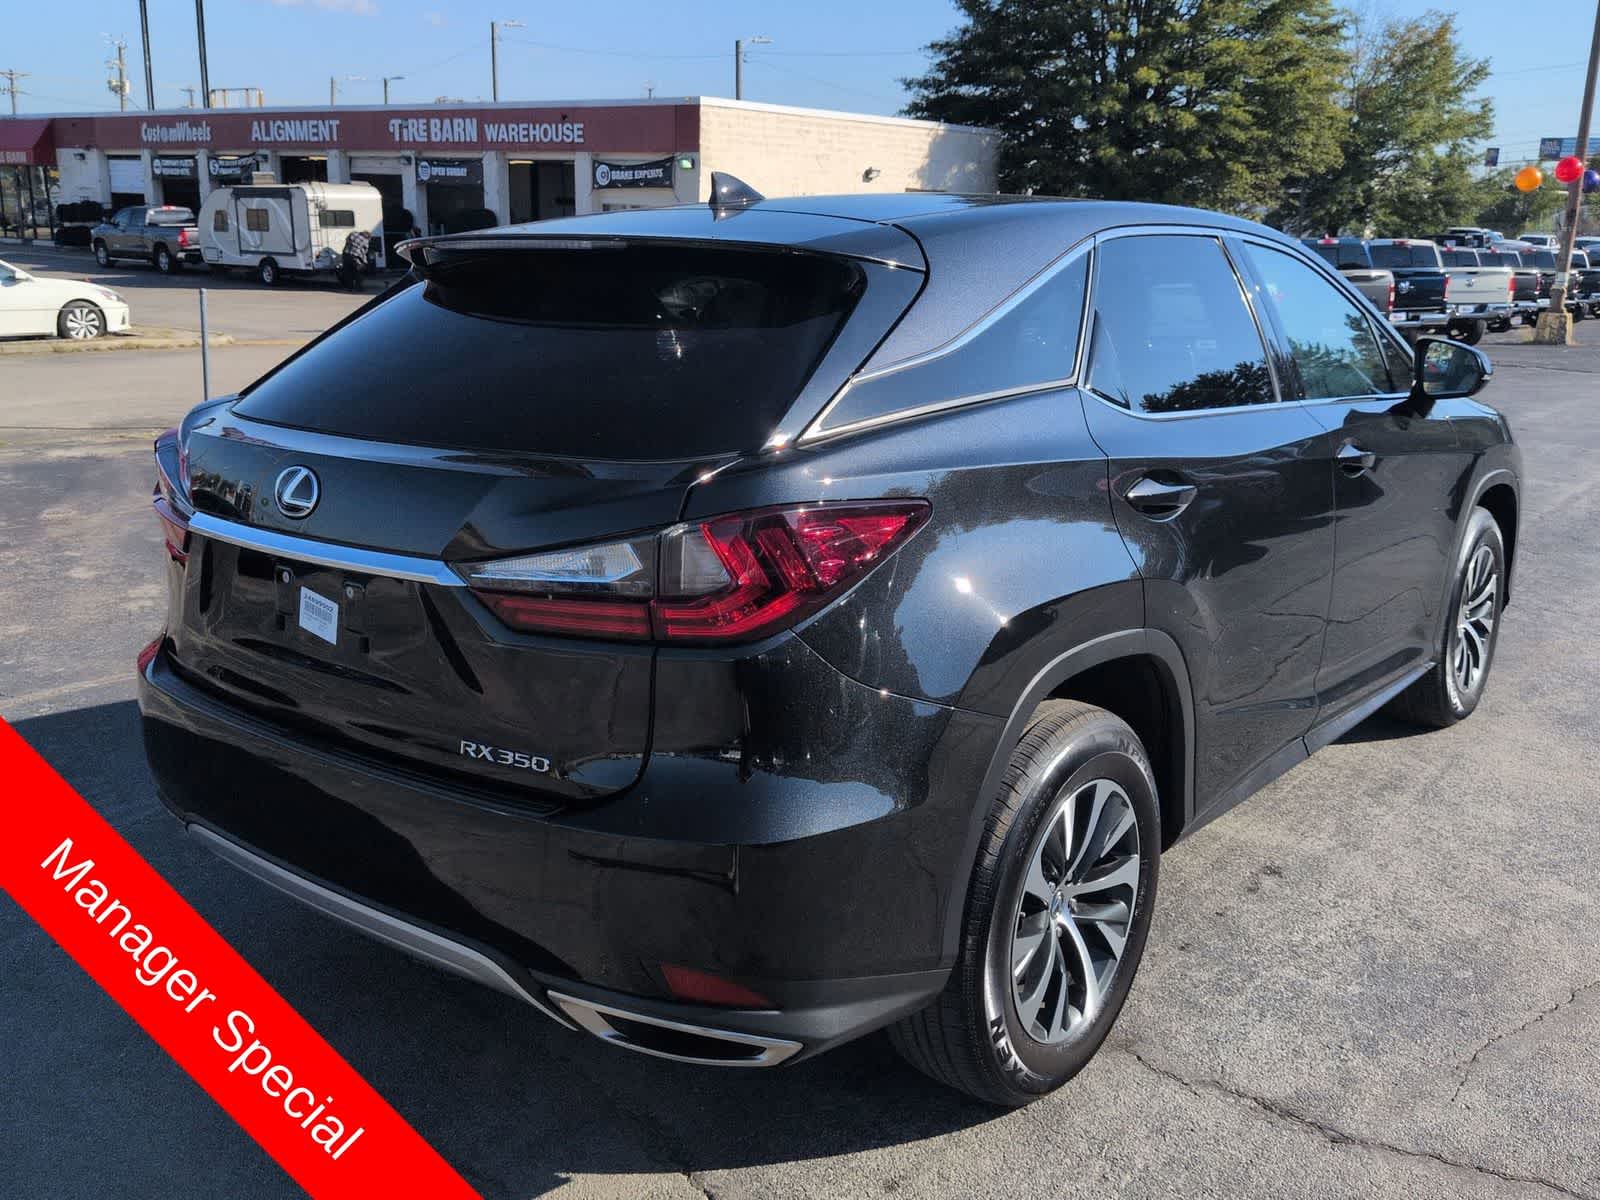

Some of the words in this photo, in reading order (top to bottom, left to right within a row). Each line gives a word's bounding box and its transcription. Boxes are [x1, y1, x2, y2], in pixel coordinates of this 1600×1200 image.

[251, 119, 340, 142] ALIGNMENT
[430, 118, 478, 142] BARN
[483, 122, 585, 143] WAREHOUSE
